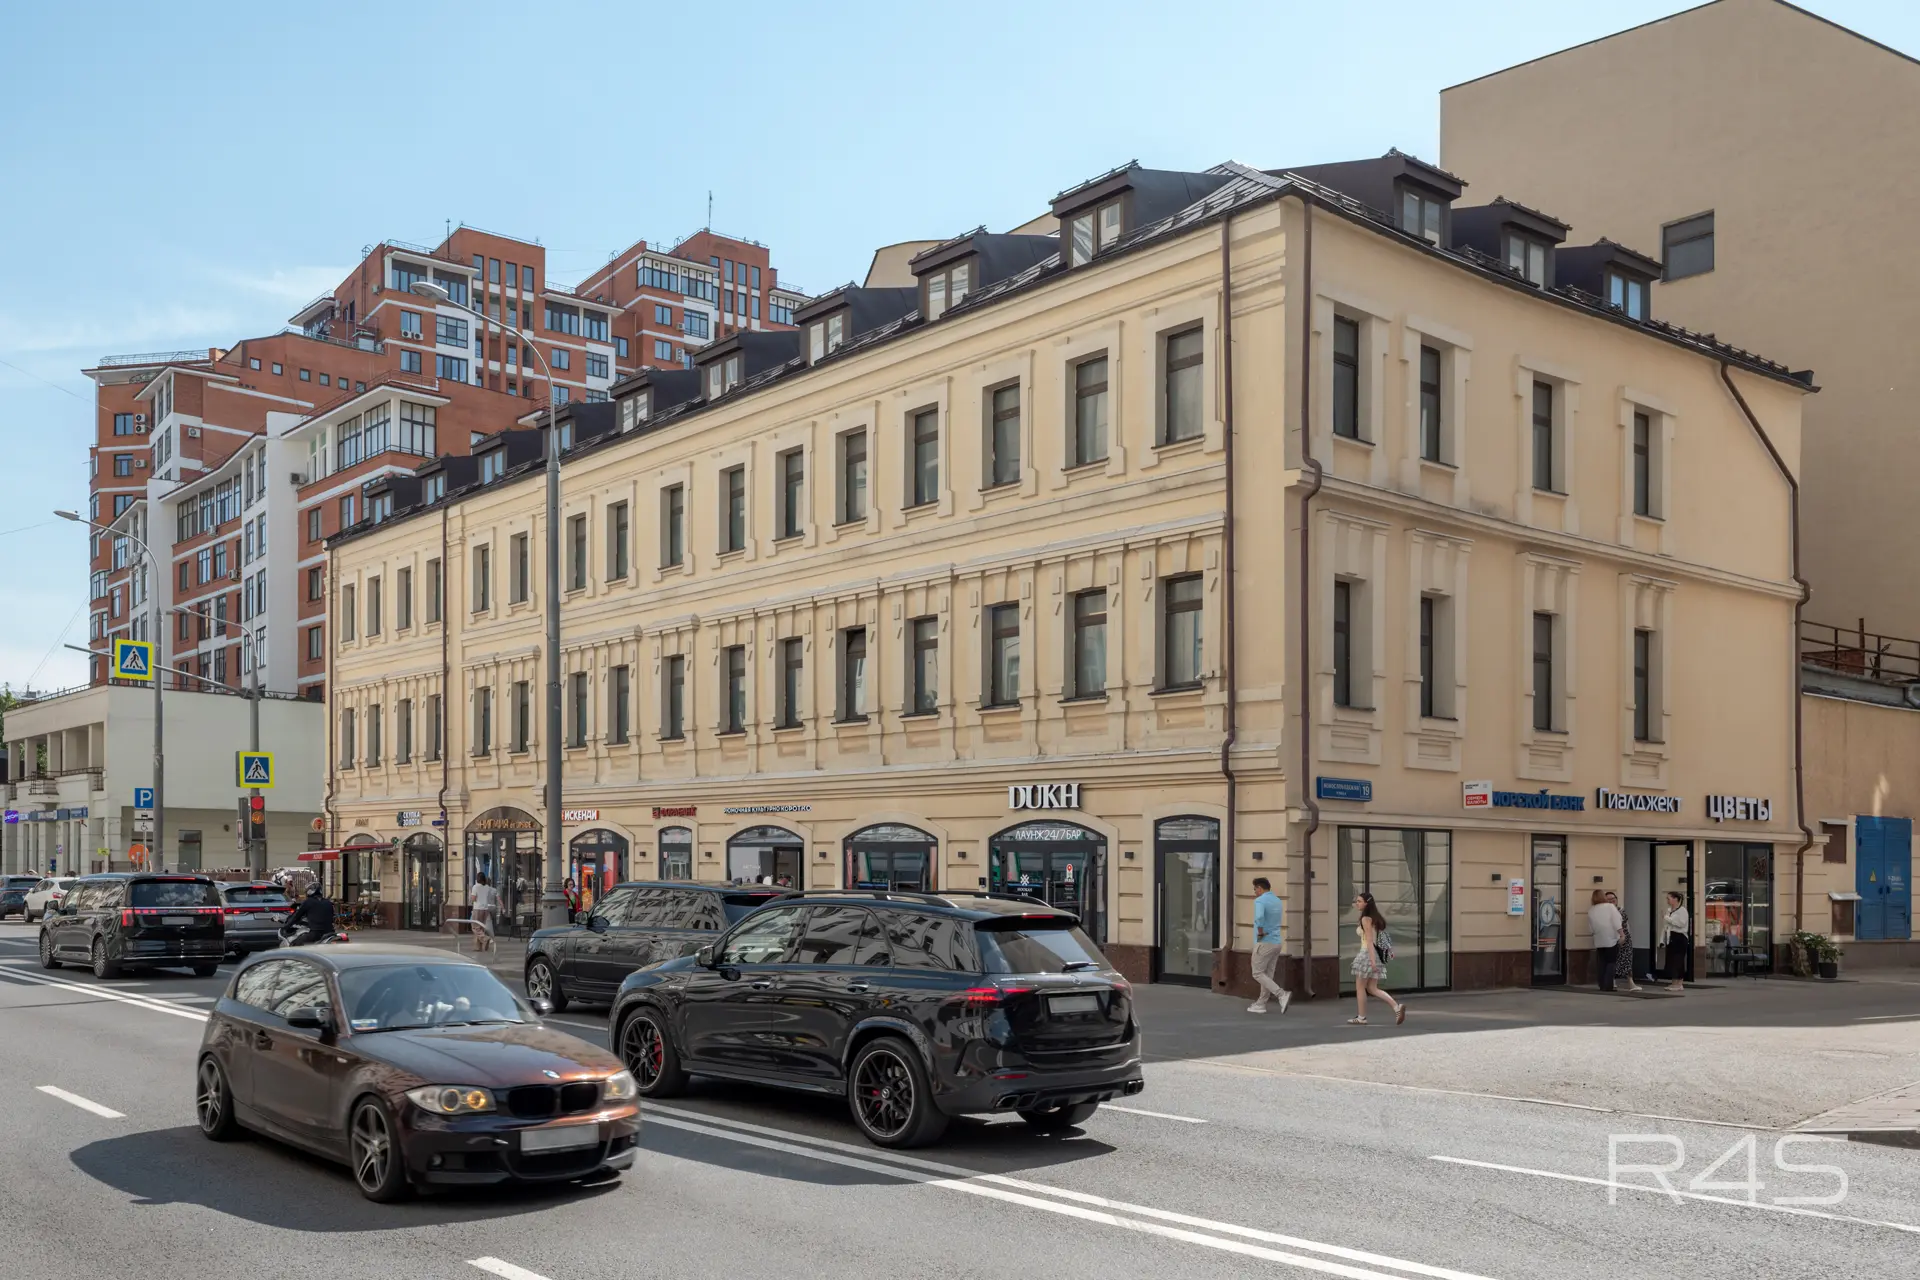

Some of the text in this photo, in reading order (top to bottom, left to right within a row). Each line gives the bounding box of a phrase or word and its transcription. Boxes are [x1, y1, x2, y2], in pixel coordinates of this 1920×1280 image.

[140, 789, 152, 807] P
[1008, 783, 1080, 809] DUKH
[1362, 785, 1370, 796] 19
[1550, 795, 1585, 811] БАНК
[1598, 787, 1683, 813] Гиалджект
[1708, 794, 1773, 823] ЦВЕТЫ
[1015, 829, 1081, 840] ЛАУНЖ 24/7 БАР
